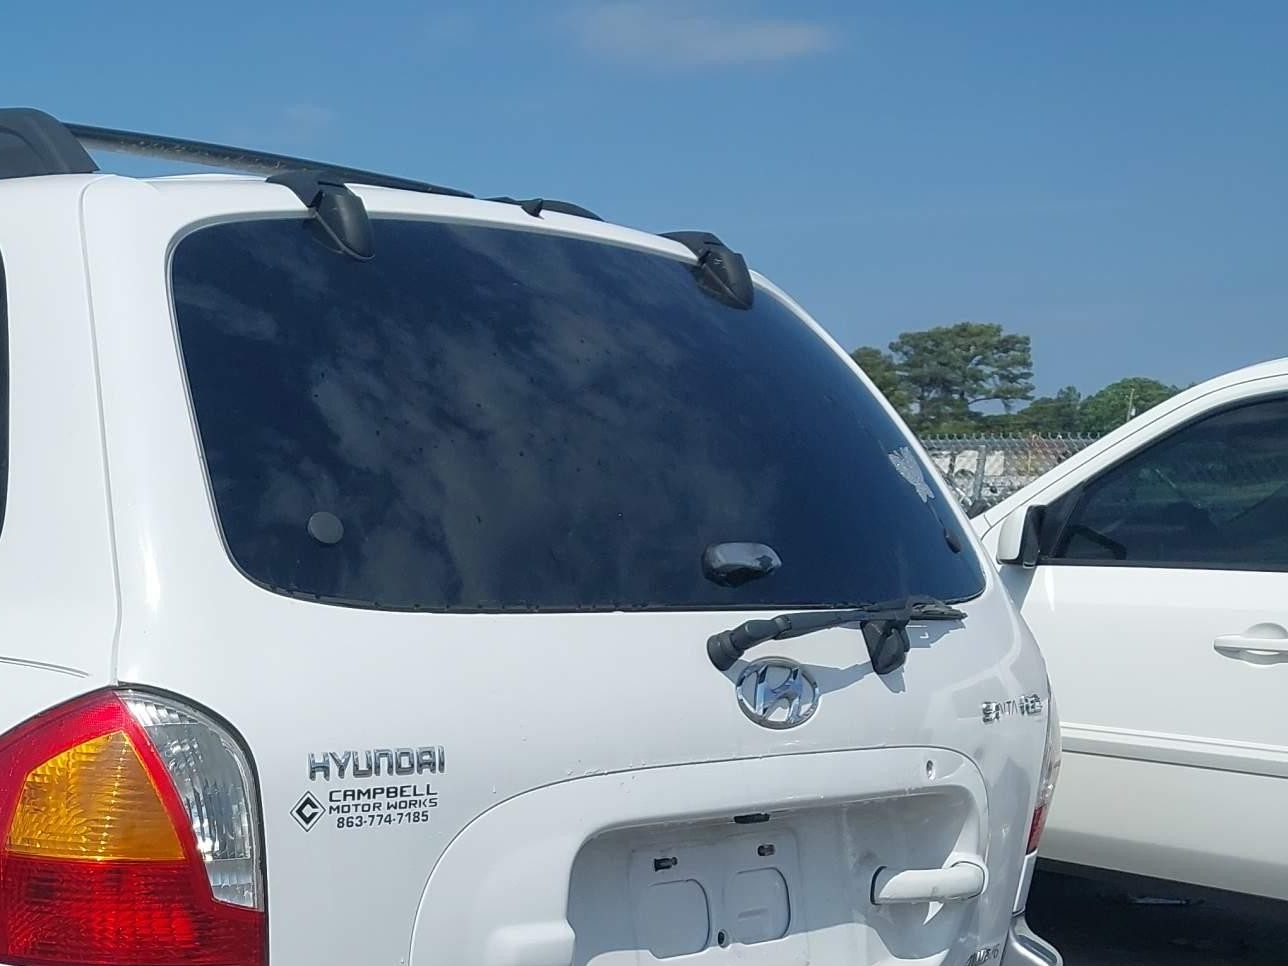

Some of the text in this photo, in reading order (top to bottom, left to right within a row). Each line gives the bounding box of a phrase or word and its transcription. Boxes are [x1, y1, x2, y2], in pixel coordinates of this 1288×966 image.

[308, 745, 445, 781] HYUNDAI
[328, 784, 438, 802] CAMPBELL
[328, 797, 438, 815] MOTOR WORKS
